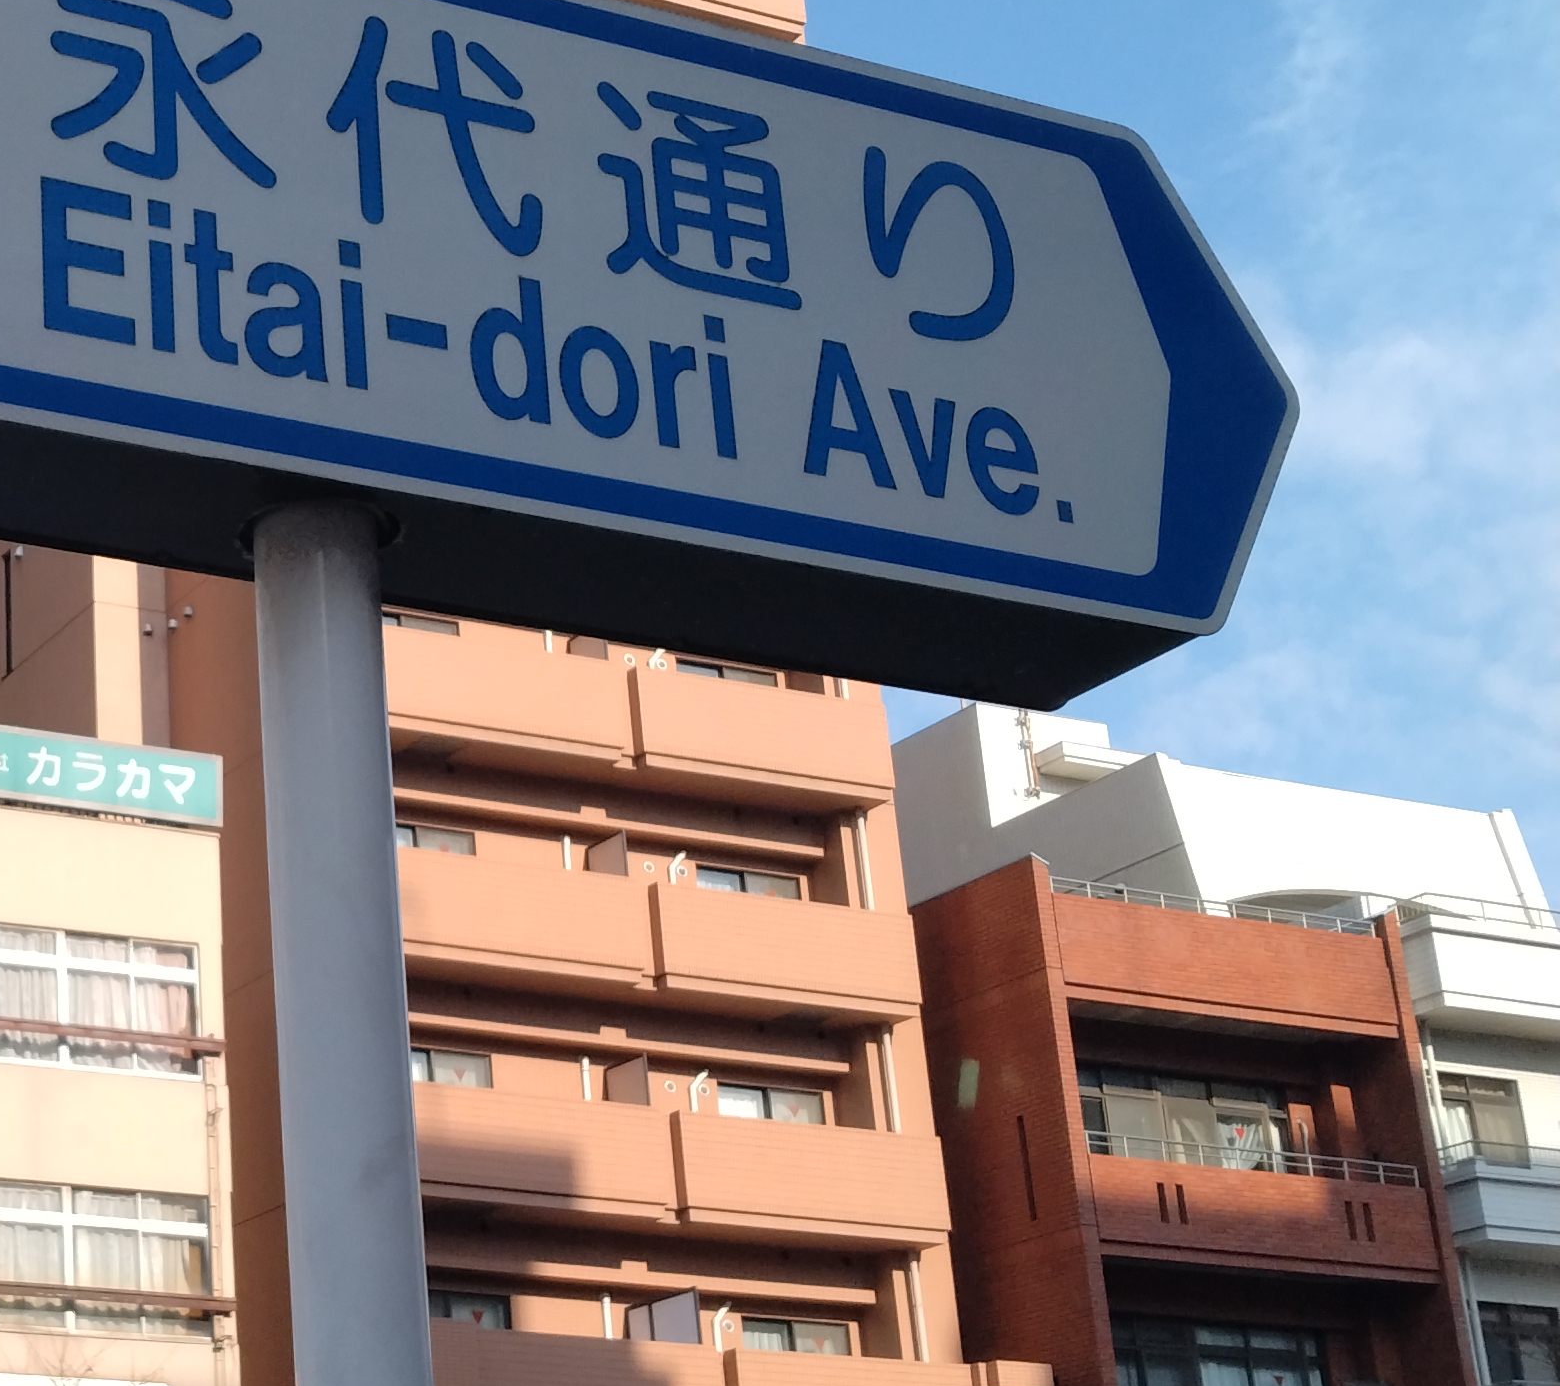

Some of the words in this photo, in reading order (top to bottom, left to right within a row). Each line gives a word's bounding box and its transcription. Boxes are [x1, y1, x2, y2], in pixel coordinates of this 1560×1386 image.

[40, 175, 739, 461] Eitai-dori
[803, 339, 1080, 525] Ave.
[26, 746, 196, 805] カラカマ
